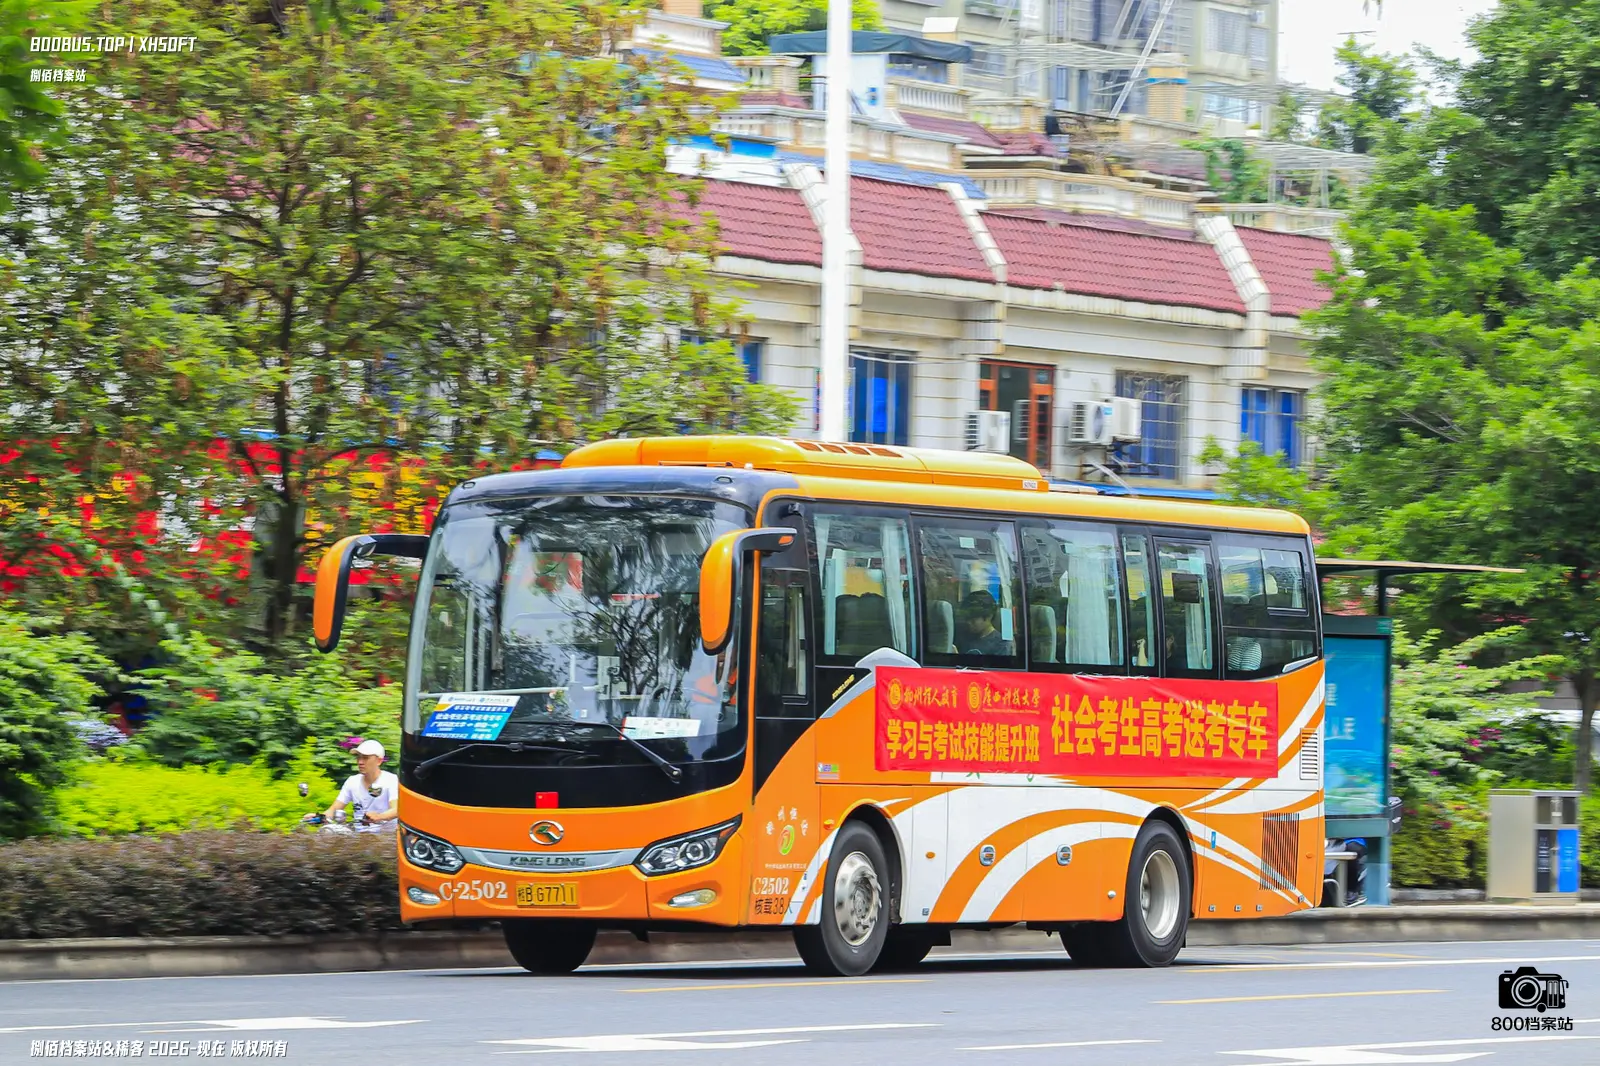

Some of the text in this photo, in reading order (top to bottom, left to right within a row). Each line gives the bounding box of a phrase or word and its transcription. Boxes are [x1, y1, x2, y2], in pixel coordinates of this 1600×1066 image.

[1051, 693, 1269, 760] 社会考生高考送考专车
[886, 718, 1040, 763] 学习与考试技能提升班
[509, 856, 586, 867] KING LONG
[439, 879, 508, 901] C-2502
[752, 876, 790, 896] C2502
[754, 896, 794, 915] 核载38人
